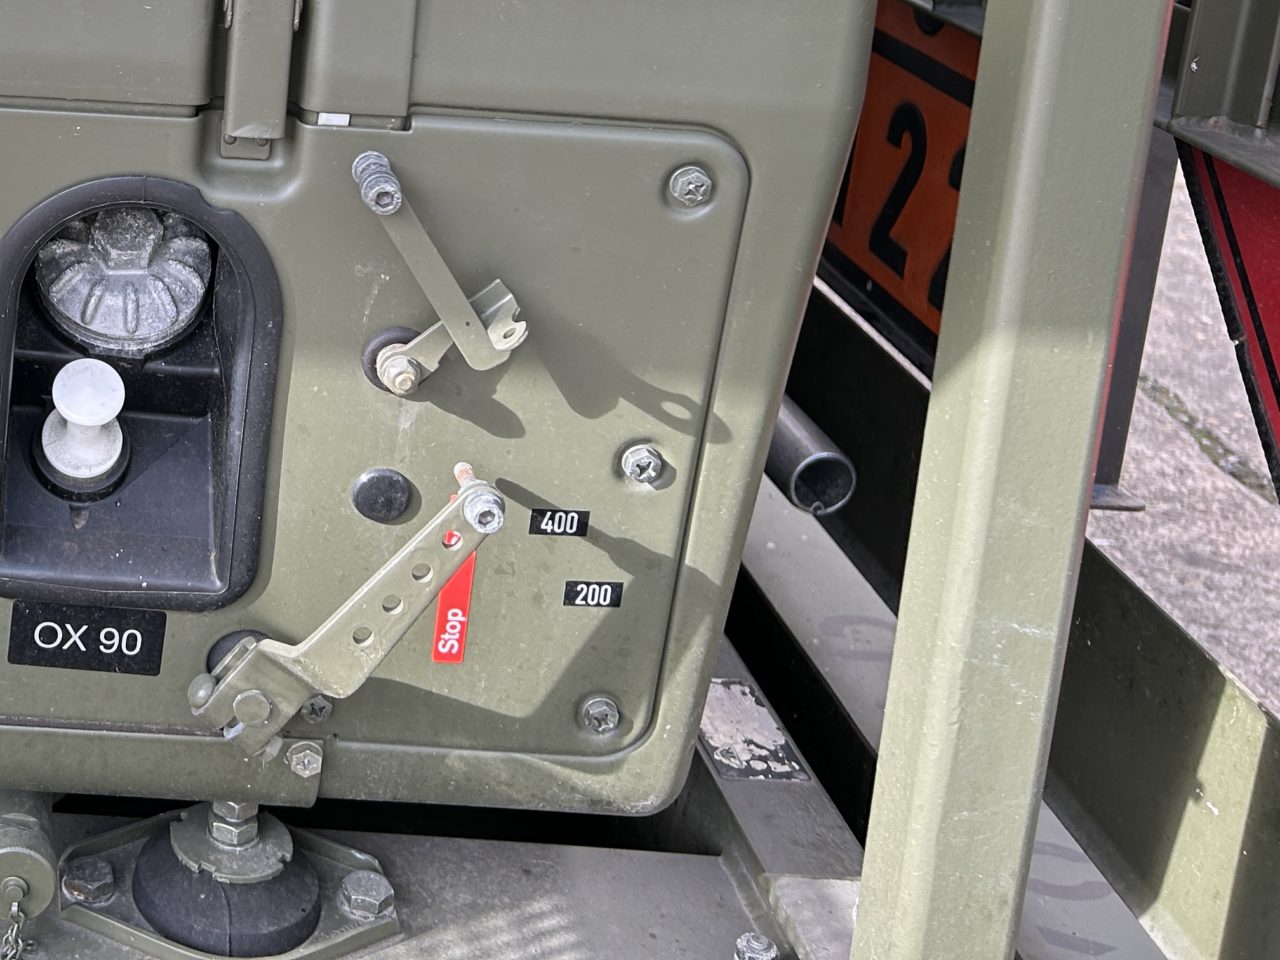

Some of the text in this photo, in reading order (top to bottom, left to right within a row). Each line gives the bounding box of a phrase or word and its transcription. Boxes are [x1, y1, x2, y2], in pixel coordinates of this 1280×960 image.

[540, 511, 579, 534] 400
[574, 583, 613, 606] 200
[33, 621, 143, 656] OX 90
[438, 608, 467, 655] Stop
